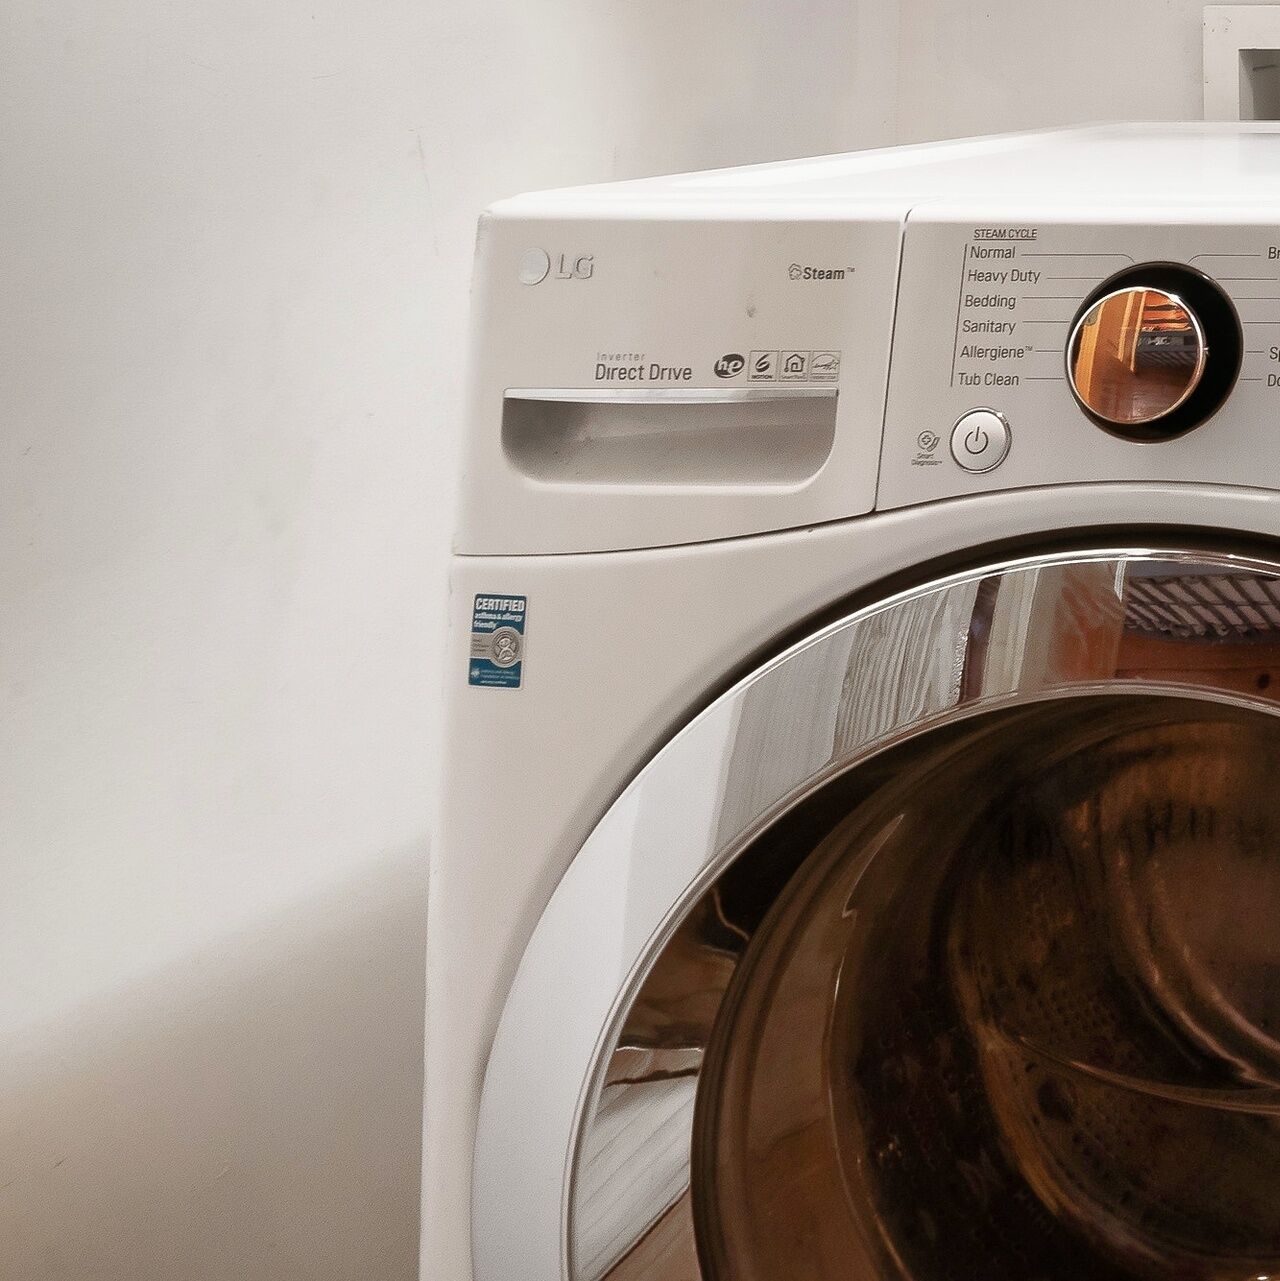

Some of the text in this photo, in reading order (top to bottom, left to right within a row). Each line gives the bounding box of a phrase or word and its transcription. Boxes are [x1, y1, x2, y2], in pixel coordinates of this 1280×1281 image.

[974, 228, 1037, 239] STEAM CYCLE
[970, 246, 1016, 259] Normal
[555, 253, 594, 280] LG
[967, 269, 1041, 284] Heavy Duty
[964, 294, 1016, 310] Bedding
[962, 319, 1017, 335] Sanitary
[596, 352, 646, 361] Inverter
[595, 363, 693, 380] Direct Drive
[958, 372, 1019, 386] Tub Clean
[475, 598, 525, 612] CERTIFIED
[474, 621, 498, 629] friendly
